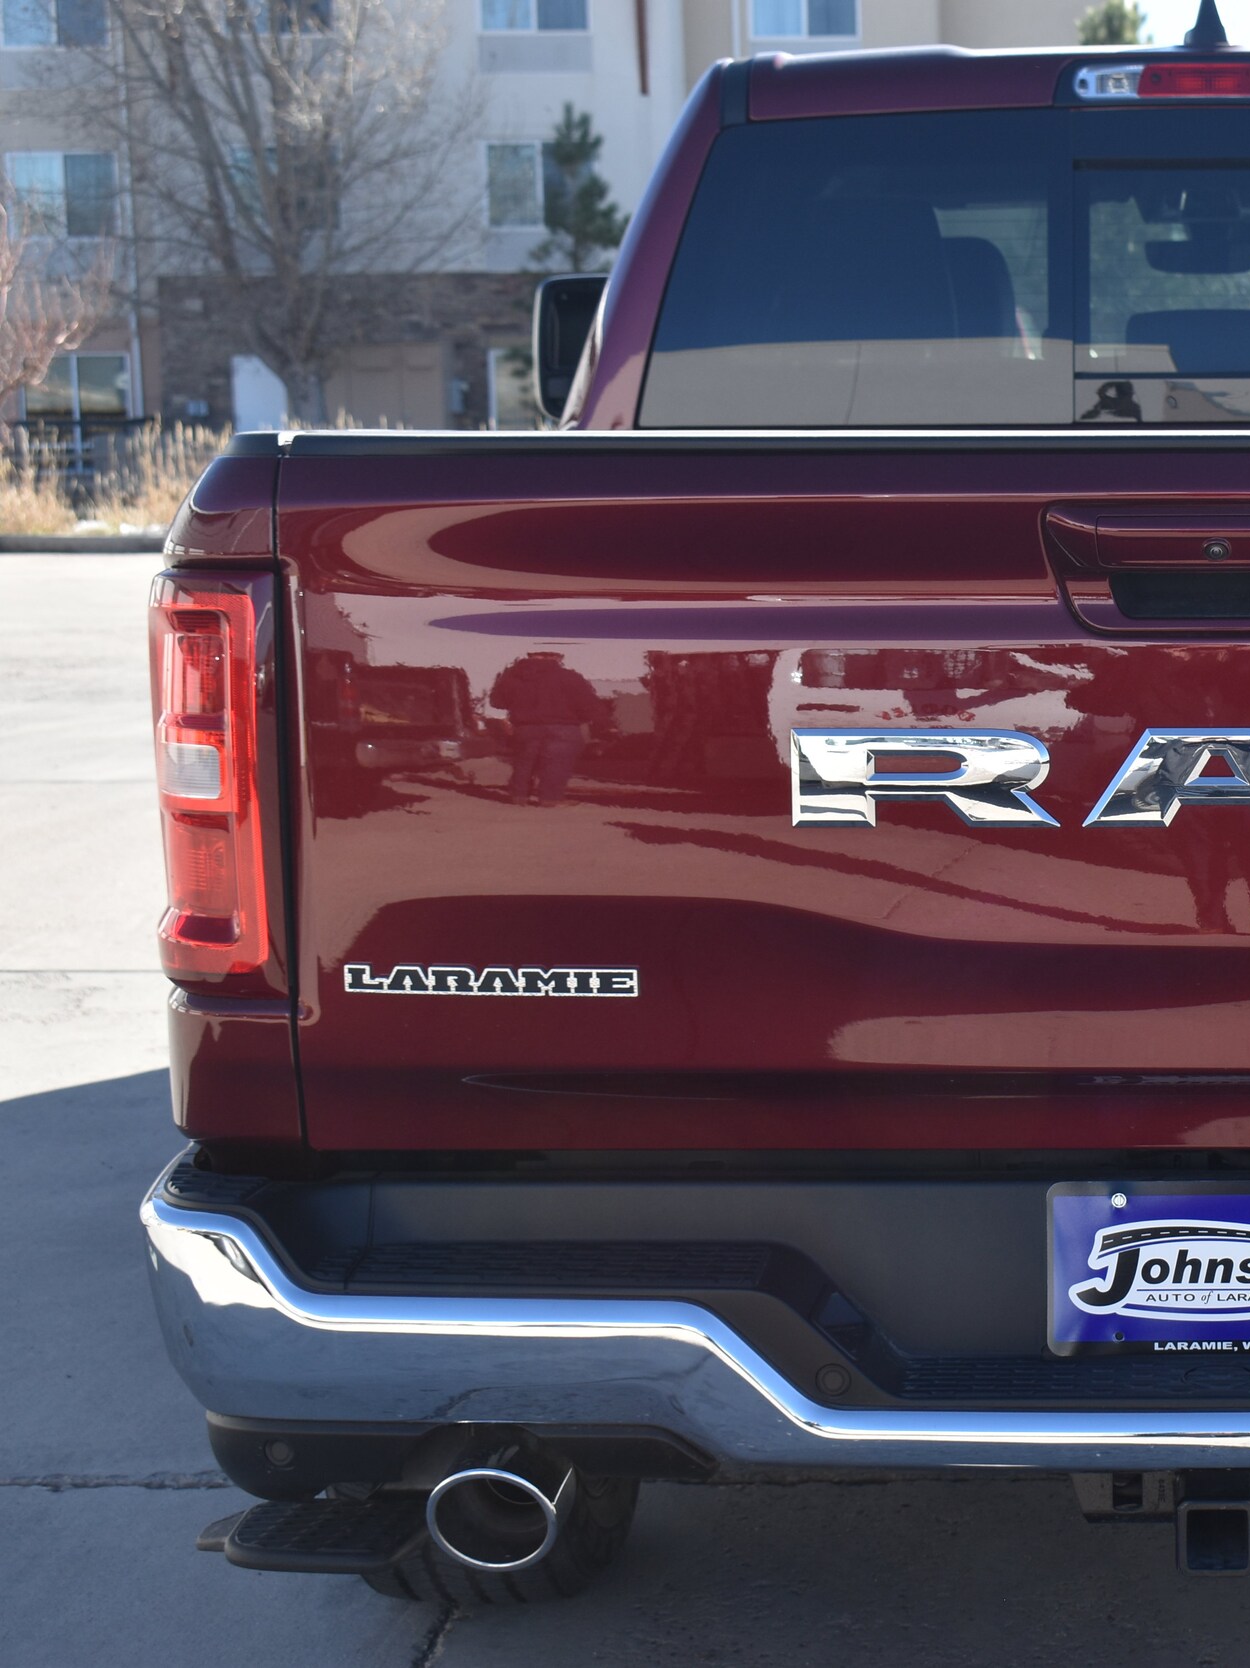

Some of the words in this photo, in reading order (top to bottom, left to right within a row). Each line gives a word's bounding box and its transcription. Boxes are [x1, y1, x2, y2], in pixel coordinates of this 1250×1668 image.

[344, 964, 639, 997] LARAMIE
[1145, 1293, 1196, 1302] AUTO
[1201, 1290, 1213, 1304] of
[1154, 1341, 1239, 1351] LARAMIE,
